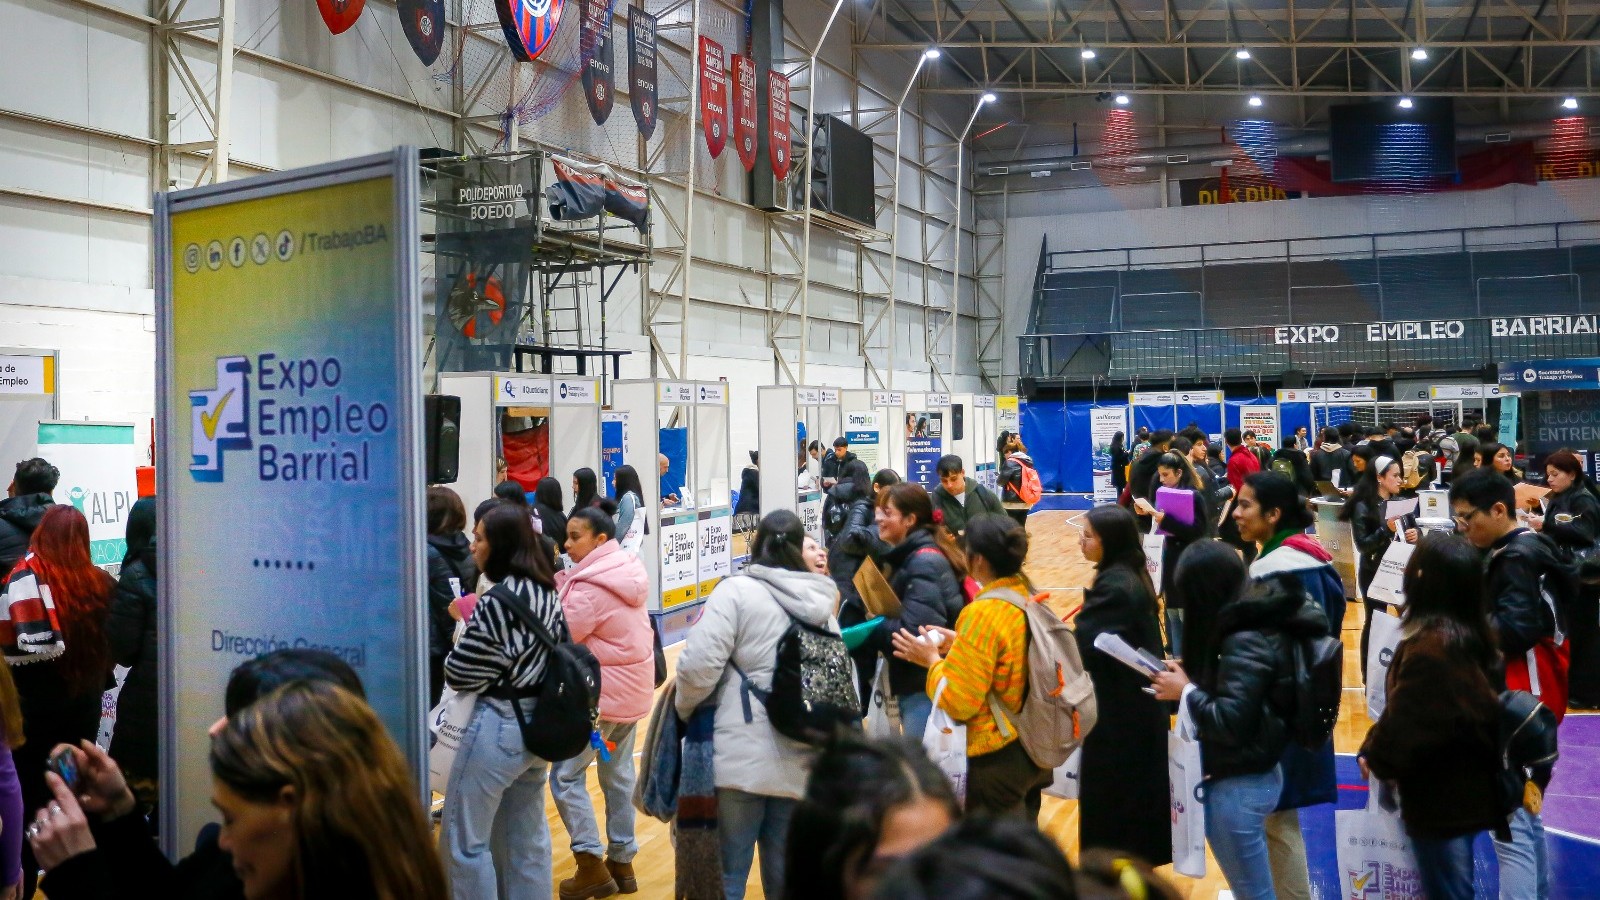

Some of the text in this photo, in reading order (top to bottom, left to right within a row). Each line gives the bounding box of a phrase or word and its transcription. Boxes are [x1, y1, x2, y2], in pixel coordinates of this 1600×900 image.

[590, 58, 609, 73] enova
[707, 102, 722, 114] enova
[459, 184, 523, 202] POLIDEPORTIVO
[471, 204, 514, 220] BOEDO
[1274, 326, 1339, 344] EXPO
[1367, 321, 1465, 342] EMPLEO
[5, 365, 16, 373] de
[258, 353, 341, 397] Expo
[258, 395, 388, 442] Empleo
[258, 441, 368, 481] Barrial
[92, 491, 130, 525] ALPI
[675, 532, 687, 541] Expo
[711, 526, 721, 534] Expo
[675, 540, 694, 552] Empleo
[711, 533, 728, 544] Empleo
[711, 542, 726, 554] Barrial
[675, 550, 692, 562] Barrial
[212, 629, 288, 655] Dirección
